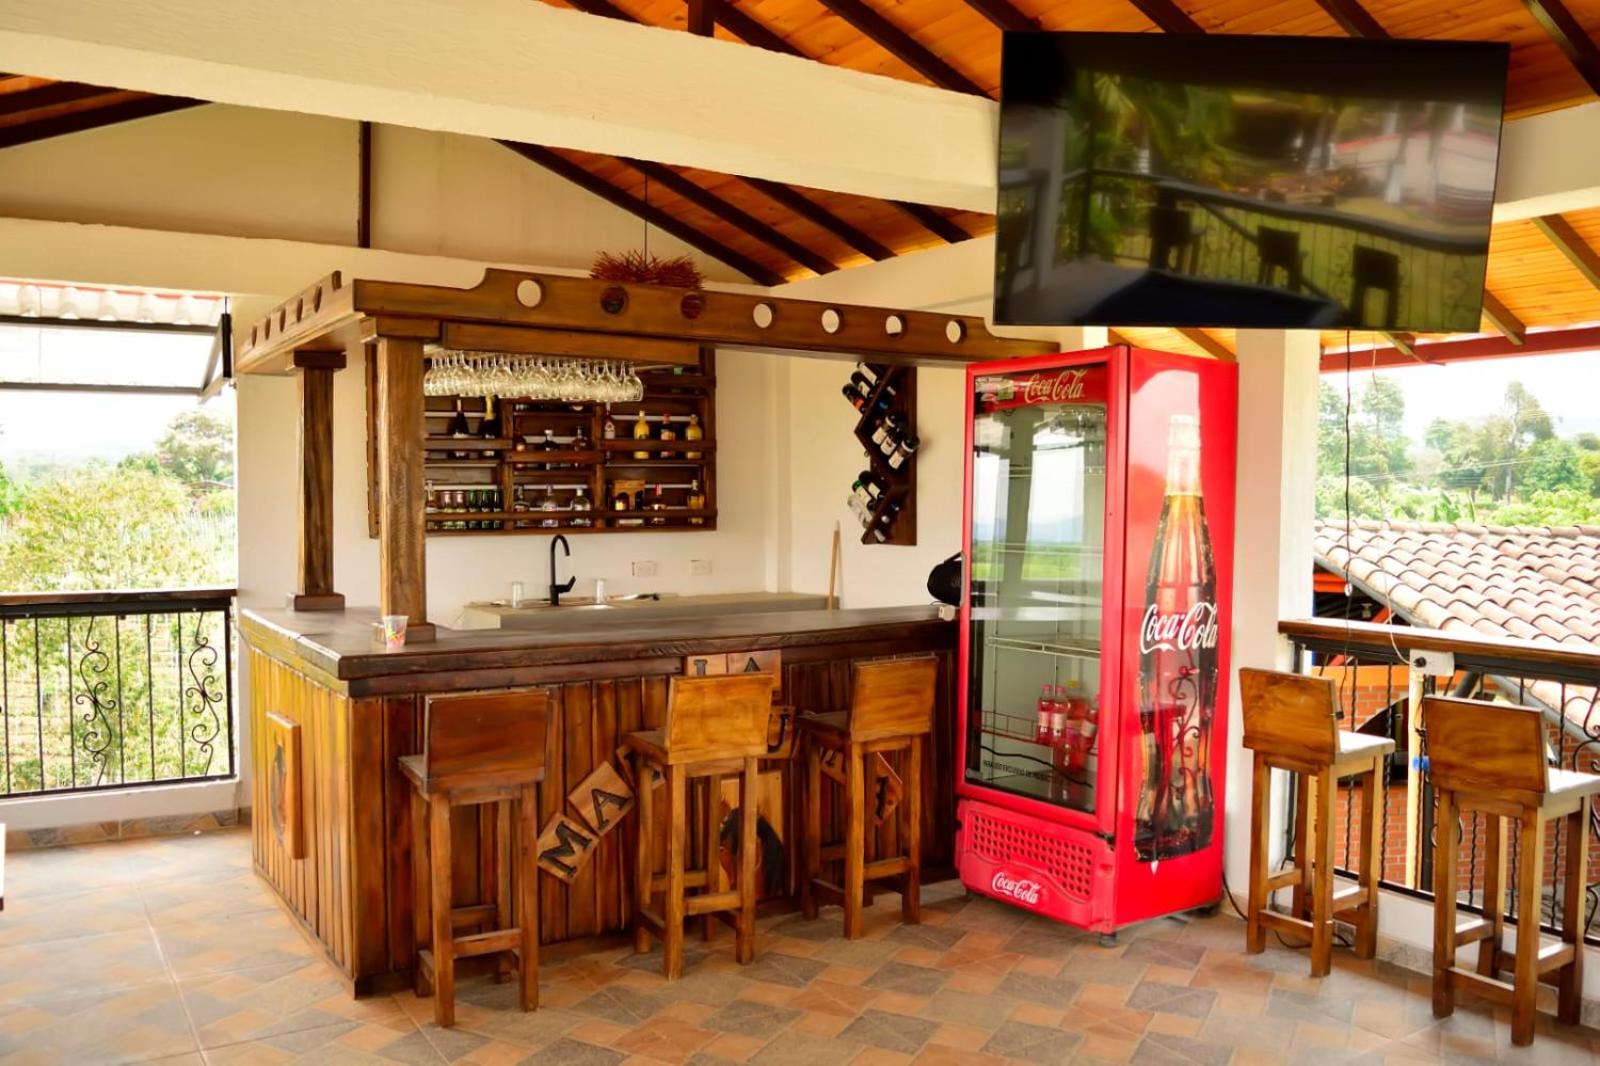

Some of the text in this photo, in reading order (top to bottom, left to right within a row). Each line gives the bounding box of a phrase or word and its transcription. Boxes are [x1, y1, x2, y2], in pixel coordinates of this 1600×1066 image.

[1024, 370, 1088, 404] Coca-Cola
[1140, 602, 1217, 654] Coca-Cola
[992, 872, 1041, 904] Coca-Cola
